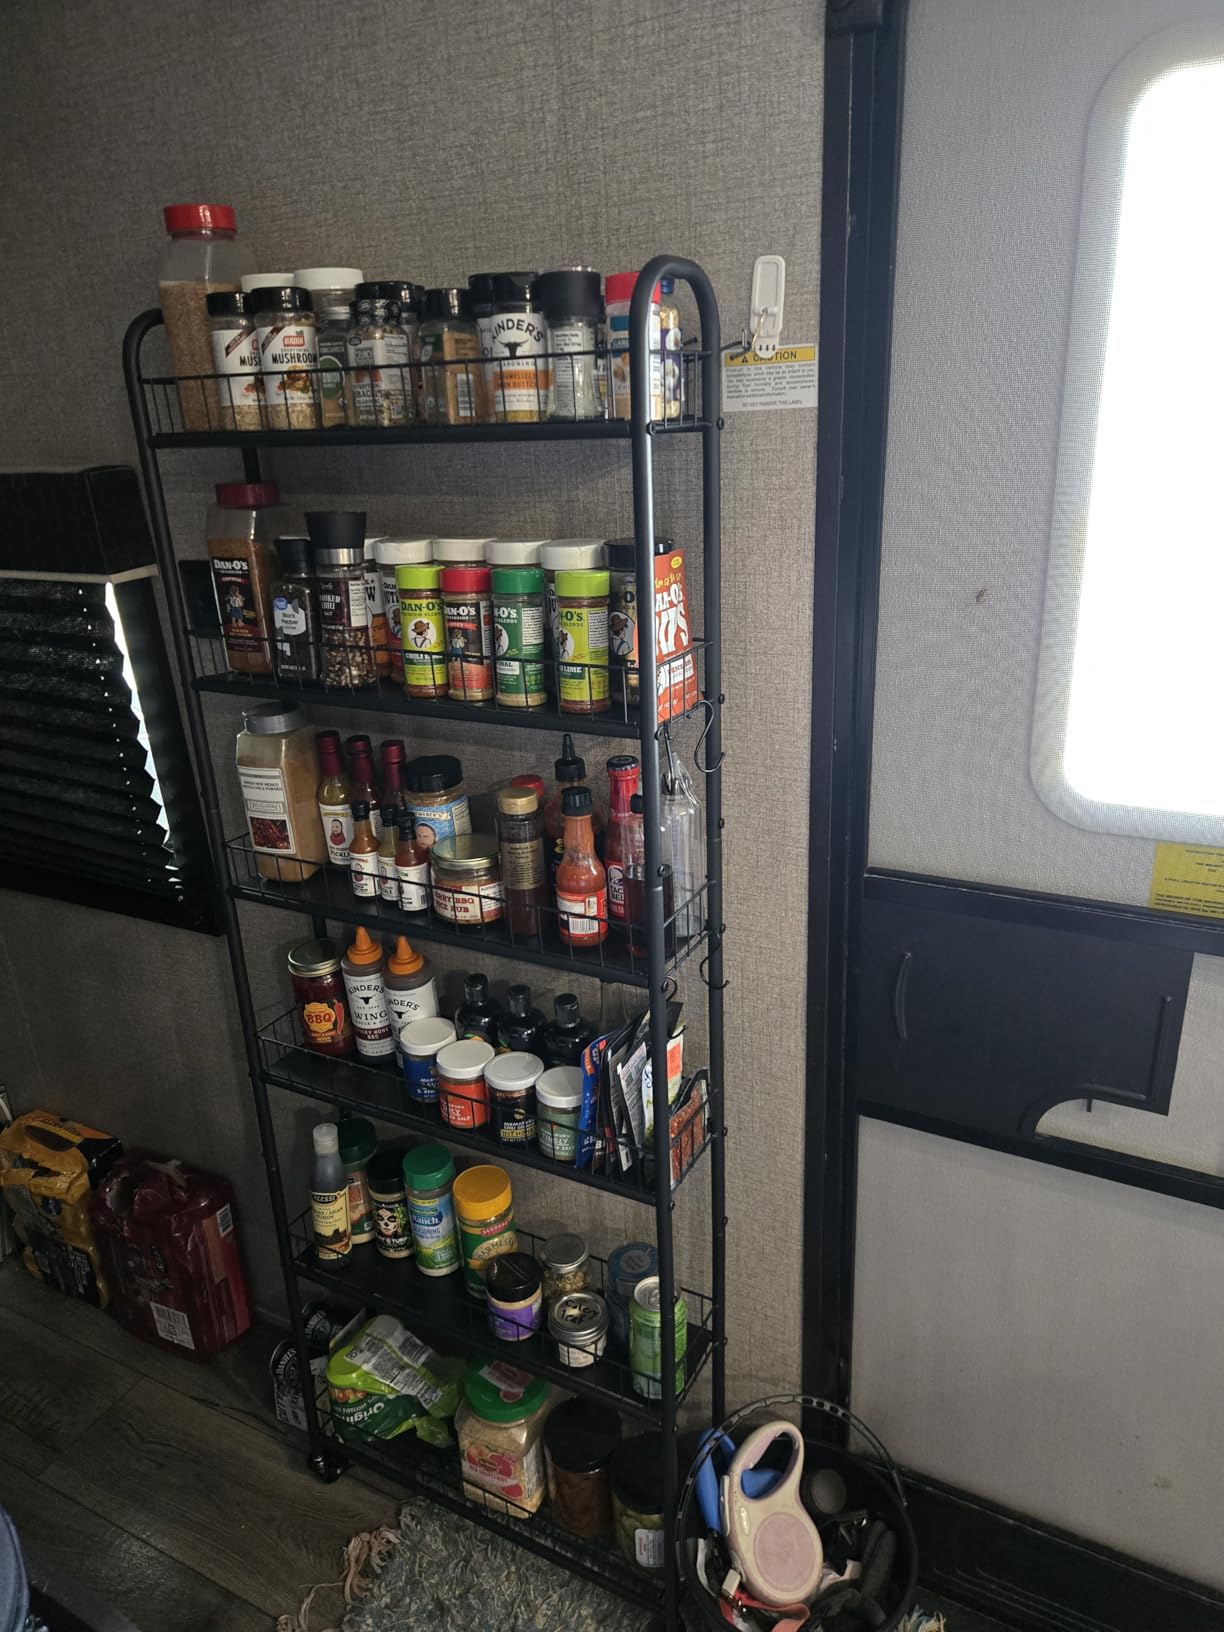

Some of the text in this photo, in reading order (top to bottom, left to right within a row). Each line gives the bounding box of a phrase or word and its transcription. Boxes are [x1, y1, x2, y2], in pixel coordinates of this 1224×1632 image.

[753, 351, 798, 363] CTION
[214, 560, 249, 570] DAN-O'S
[496, 607, 518, 619] -O'S
[560, 611, 583, 622] -O'S
[306, 1014, 333, 1025] BBQ
